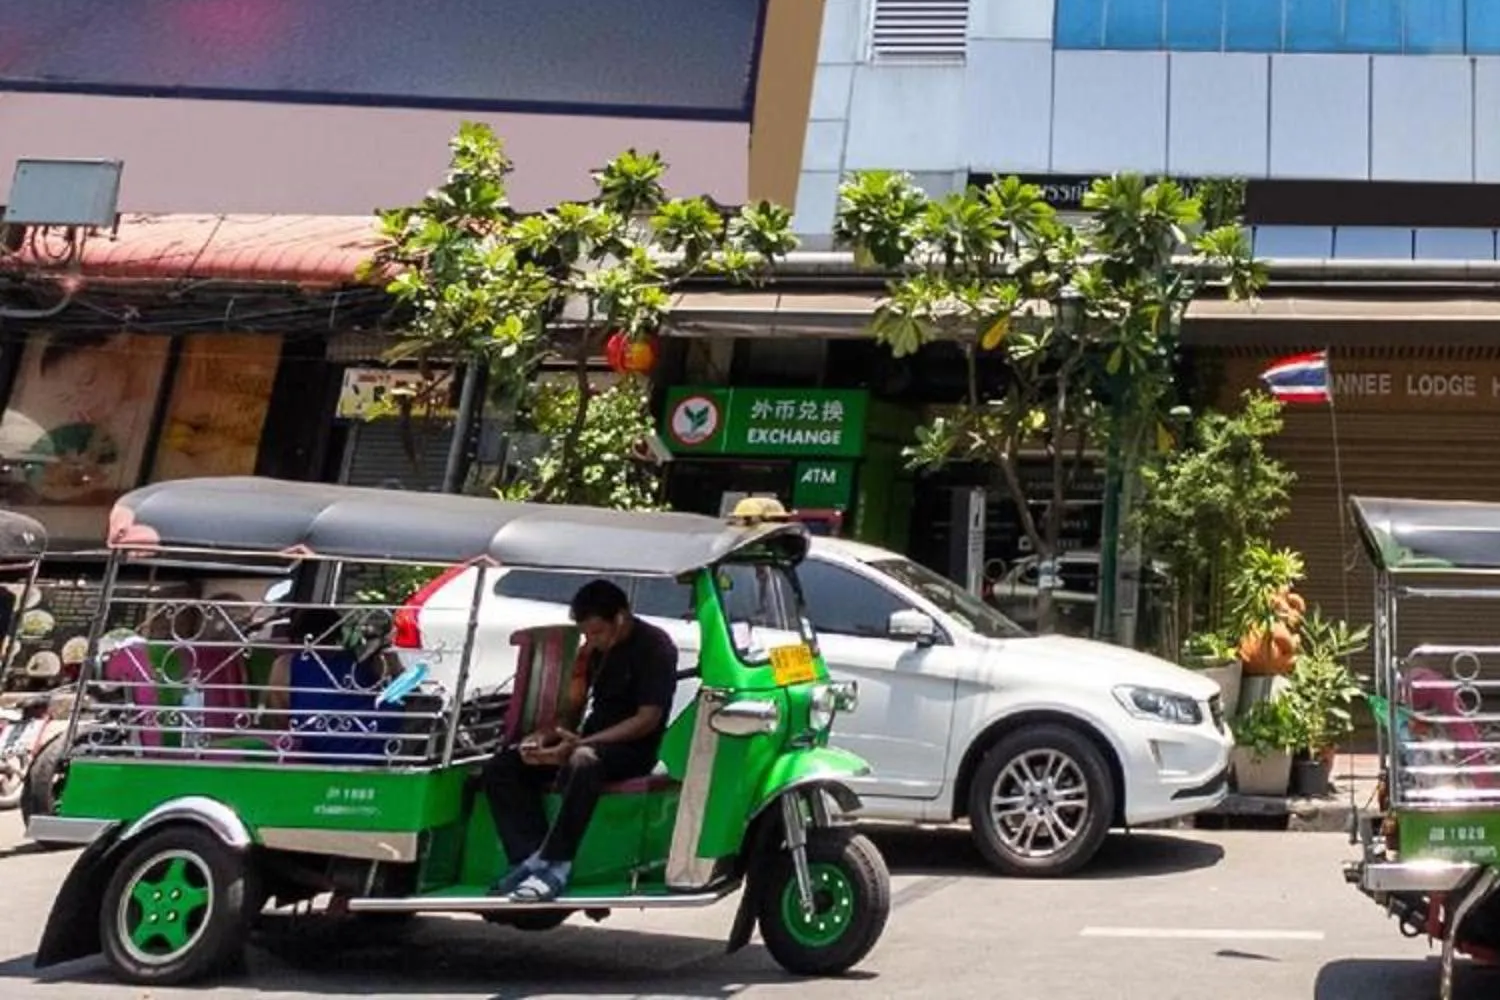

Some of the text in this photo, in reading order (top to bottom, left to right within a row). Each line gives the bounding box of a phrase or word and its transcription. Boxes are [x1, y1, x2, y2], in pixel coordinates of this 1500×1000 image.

[1407, 375, 1477, 397] LODGE
[751, 399, 844, 422] 外币兑换
[747, 428, 842, 445] EXCHANGE
[801, 467, 837, 484] ATM
